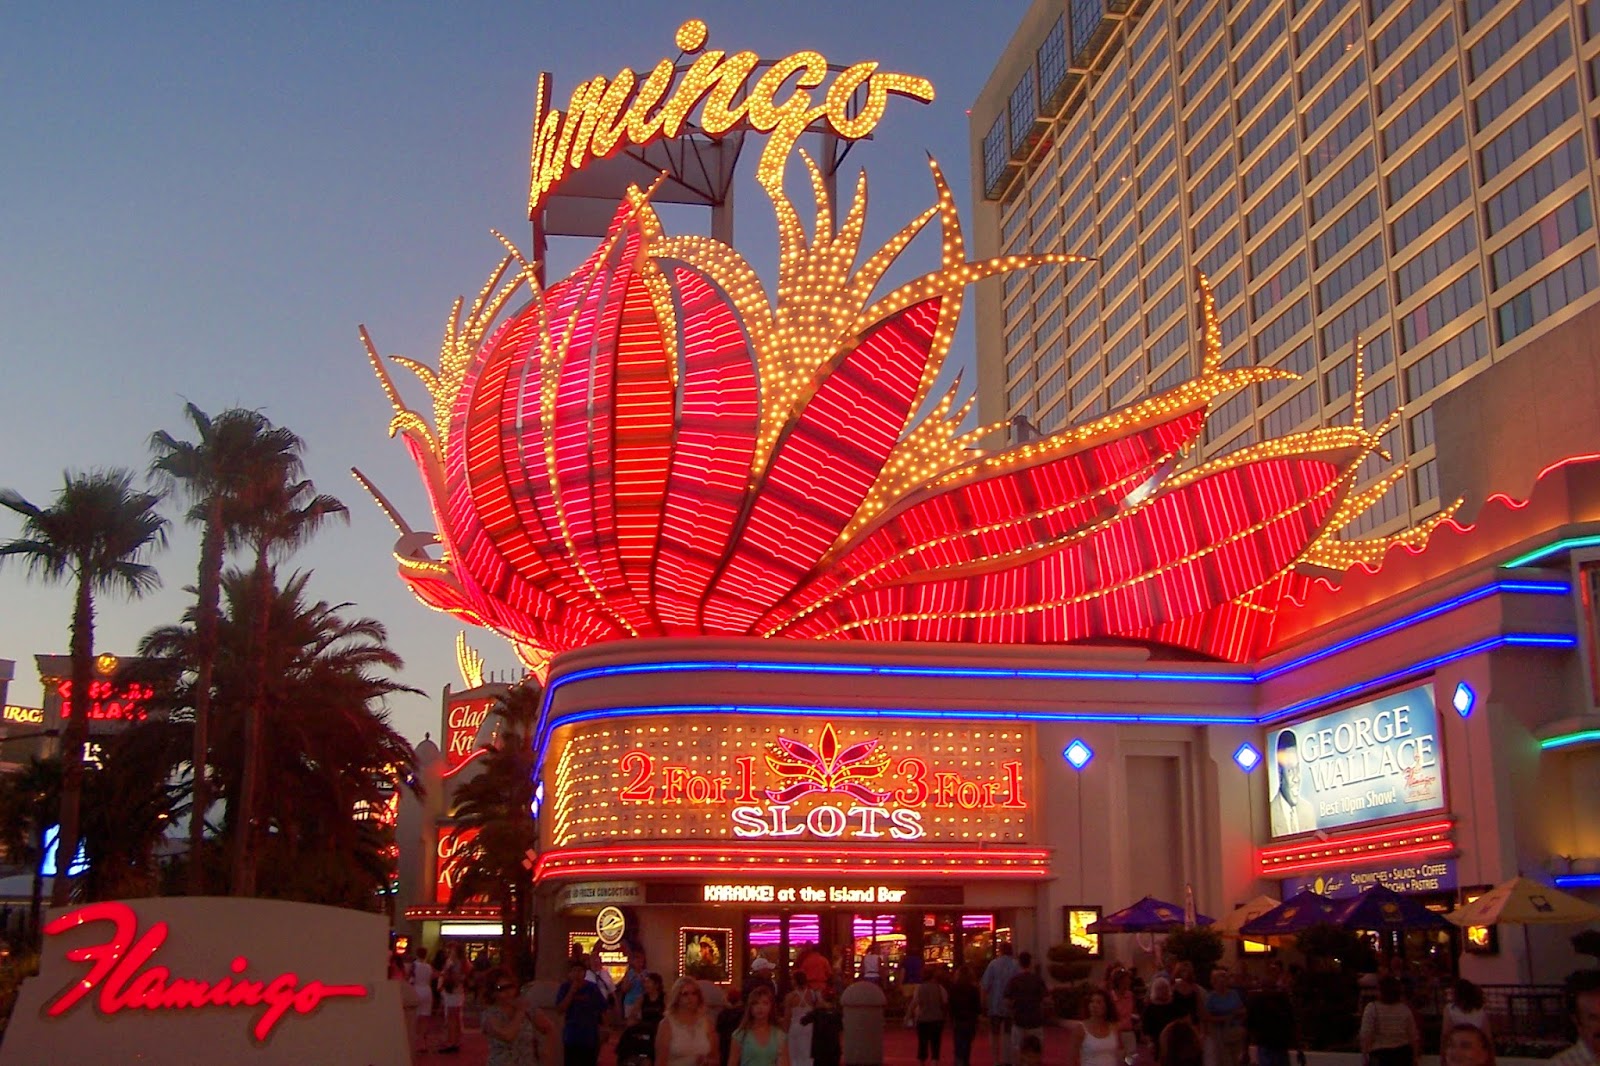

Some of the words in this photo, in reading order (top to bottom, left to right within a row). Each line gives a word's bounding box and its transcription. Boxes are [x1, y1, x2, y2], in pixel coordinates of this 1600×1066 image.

[1301, 705, 1413, 763] GEORGE
[620, 751, 655, 802] 2
[662, 766, 733, 803] For
[734, 756, 760, 804] 1
[895, 757, 929, 805] 3
[935, 771, 1000, 809] For
[1001, 761, 1027, 809] 1
[1309, 735, 1435, 792] WALLACE
[731, 806, 924, 839] SLOTS
[1319, 798, 1339, 817] Best
[1342, 795, 1365, 815] 10pm
[1367, 787, 1397, 808] Show!
[1392, 868, 1416, 880] SALADS
[1421, 864, 1447, 876] COFFEE
[1411, 878, 1439, 890] PASTRIES
[704, 885, 775, 901] KARAOKE!
[777, 887, 796, 901] at
[799, 886, 827, 901] the
[830, 886, 875, 902] Island
[877, 886, 907, 903] Bar
[42, 901, 368, 1041] Flamingo
